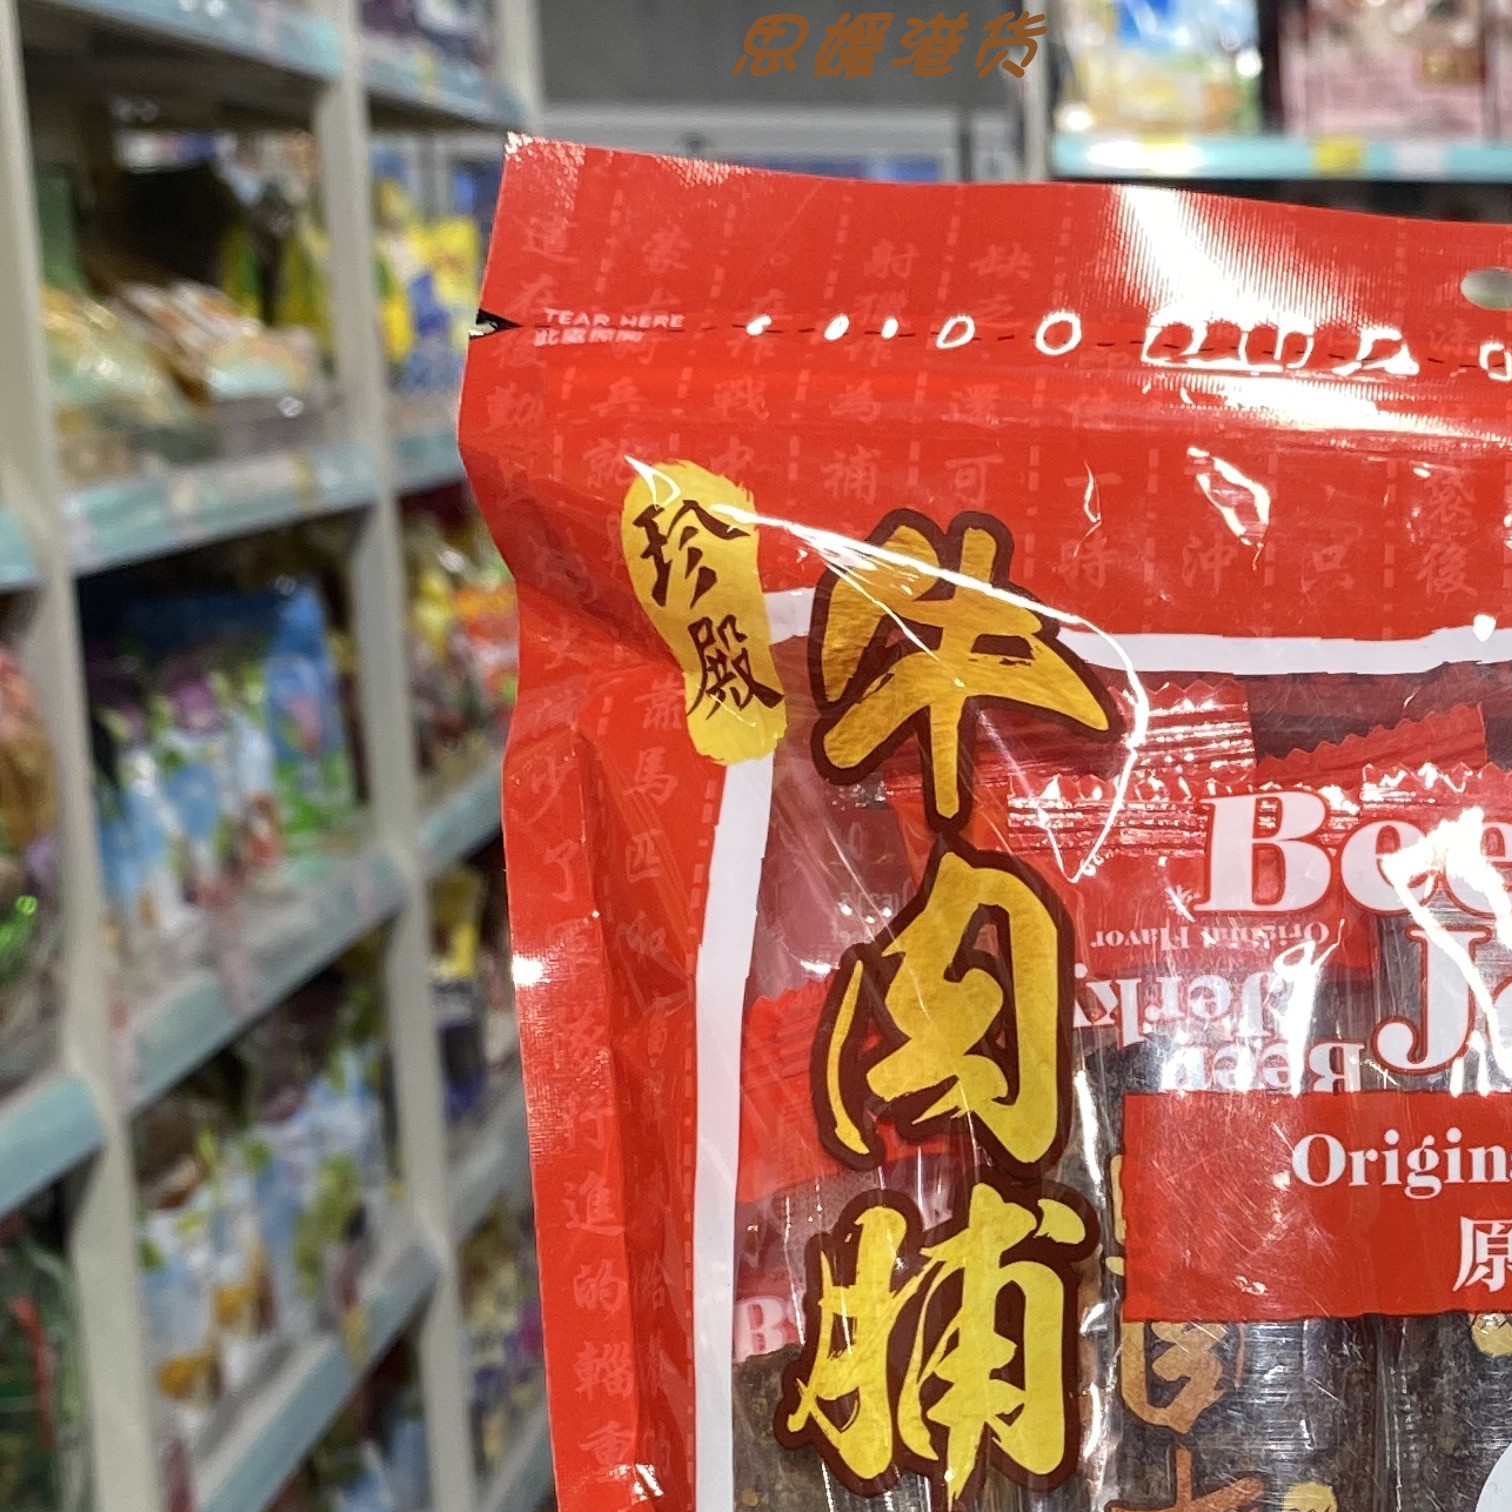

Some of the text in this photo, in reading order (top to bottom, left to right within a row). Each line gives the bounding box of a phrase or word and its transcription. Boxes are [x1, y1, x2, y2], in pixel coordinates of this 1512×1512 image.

[543, 307, 686, 329] TEAR HERE
[632, 499, 786, 720] 珍殿
[1073, 962, 1286, 1050] Jerk
